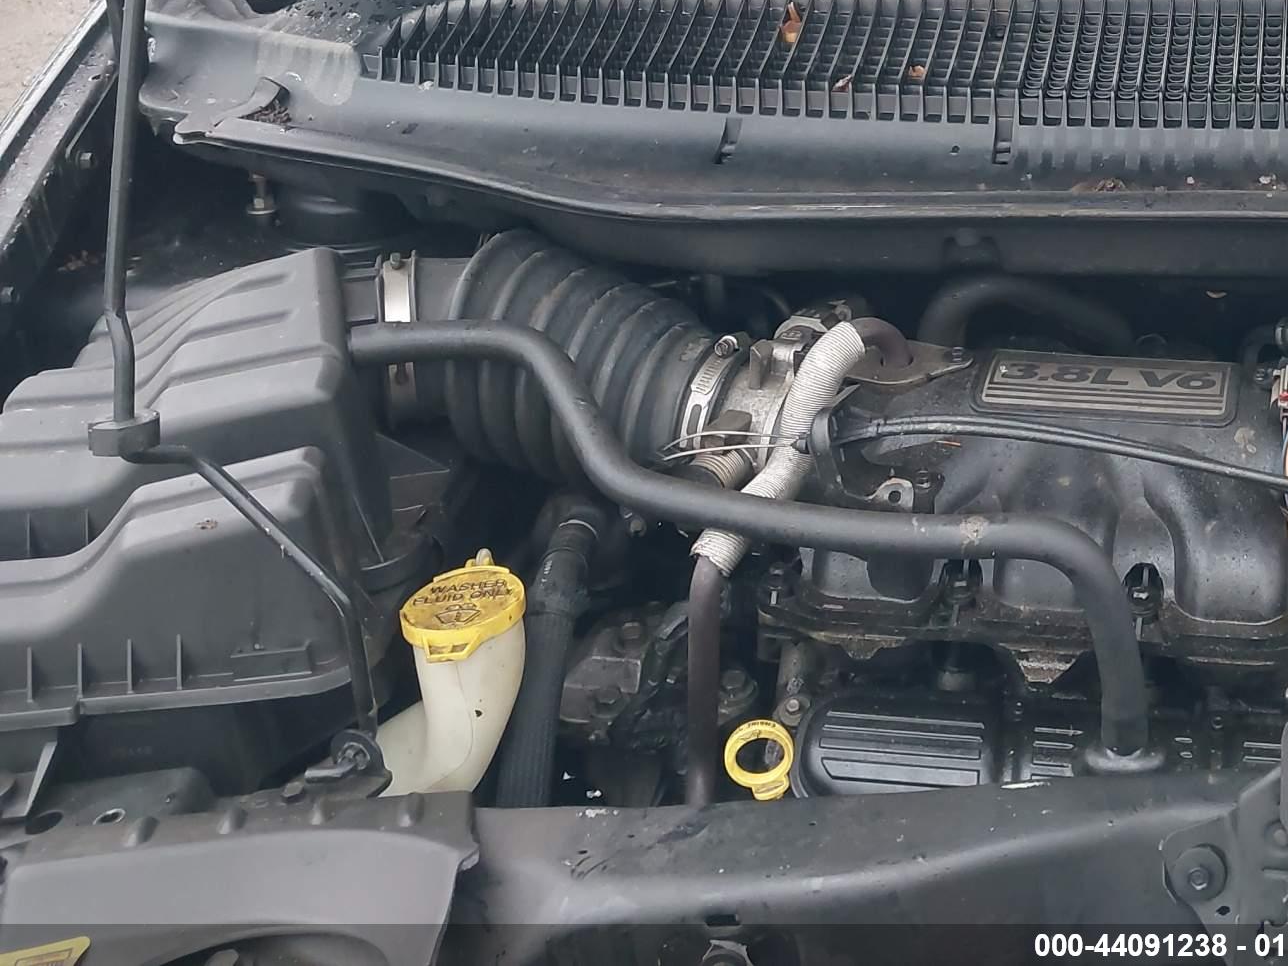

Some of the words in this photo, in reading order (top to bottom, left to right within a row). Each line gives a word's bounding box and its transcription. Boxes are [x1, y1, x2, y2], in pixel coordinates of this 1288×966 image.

[1001, 363, 1129, 386] 3.8L
[1139, 370, 1217, 390] V6
[413, 593, 465, 606] FLUID
[470, 586, 513, 600] ONLY
[430, 579, 508, 594] WASHER
